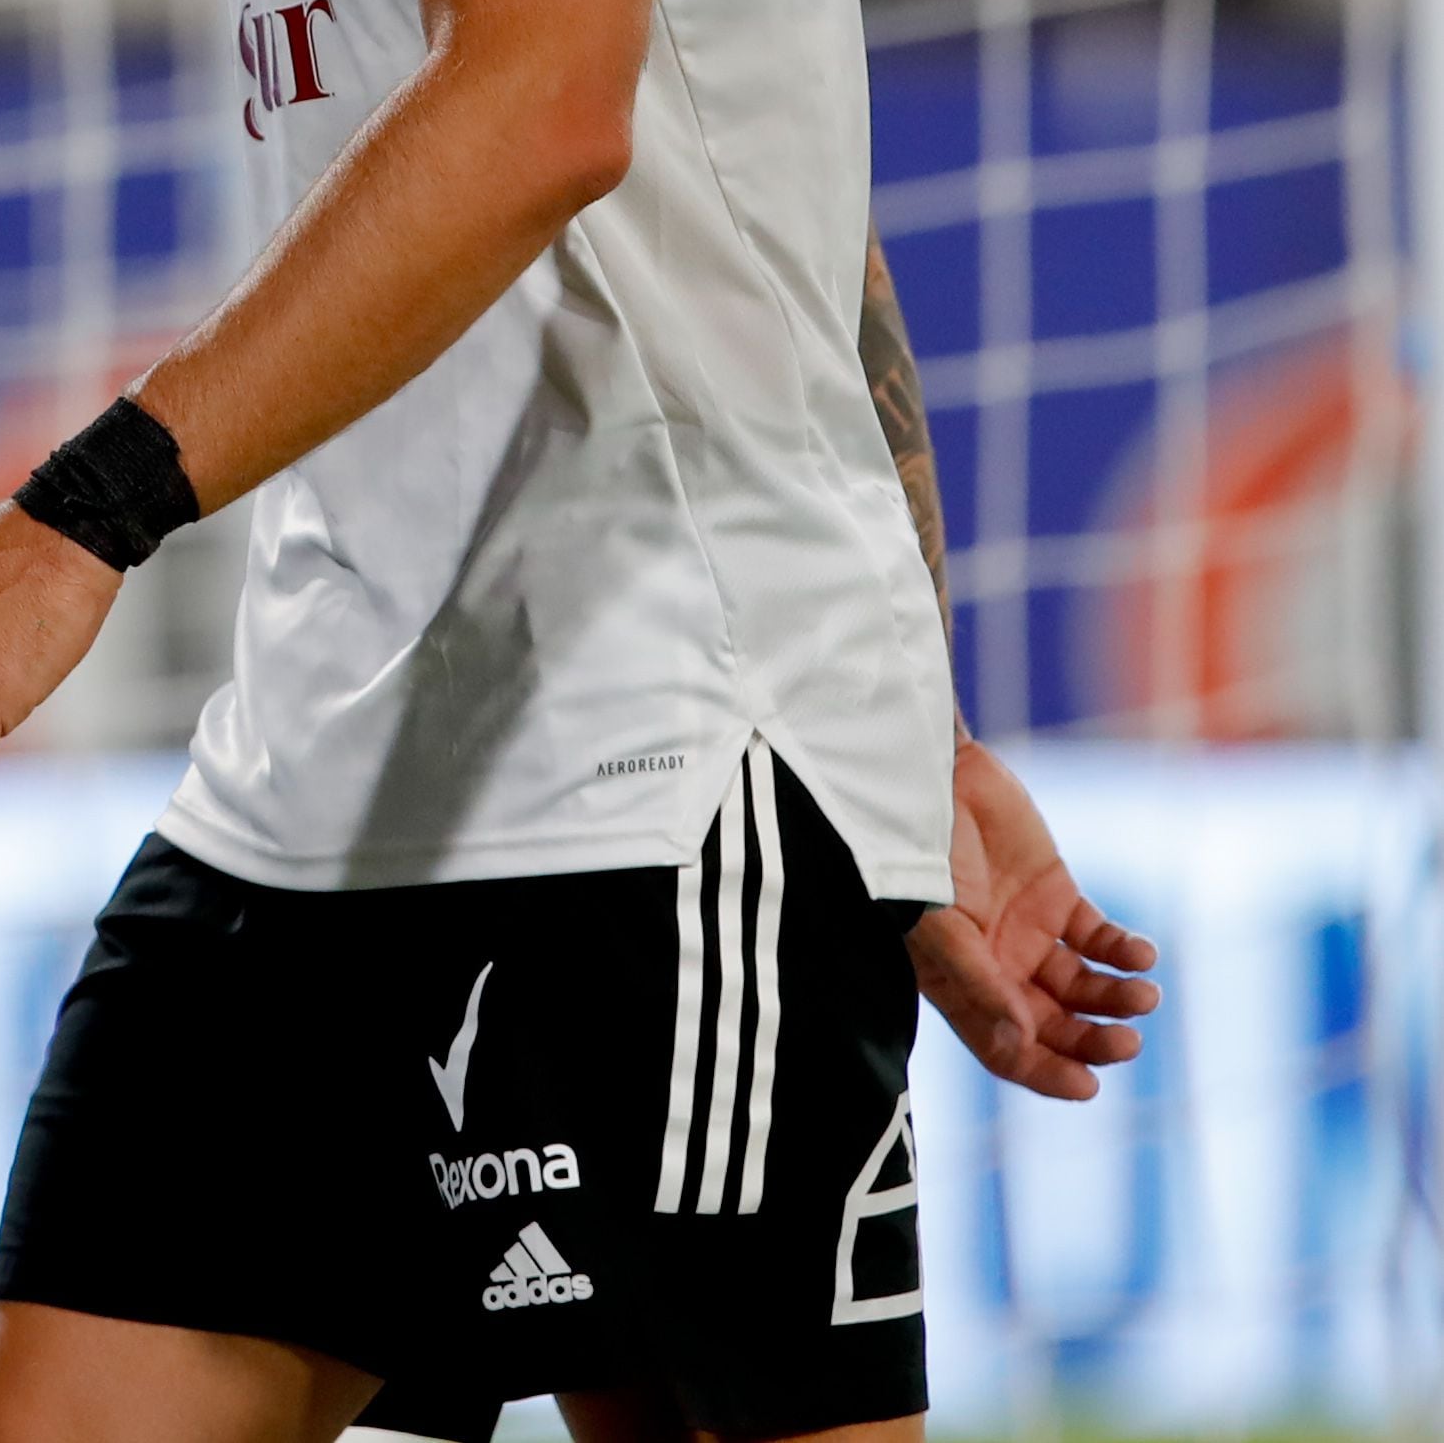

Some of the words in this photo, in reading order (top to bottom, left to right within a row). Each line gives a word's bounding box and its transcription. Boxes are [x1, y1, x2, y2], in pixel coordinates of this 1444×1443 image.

[597, 755, 685, 776] AEROREADY
[428, 1143, 581, 1210] Rexona
[482, 1273, 594, 1311] adidas
